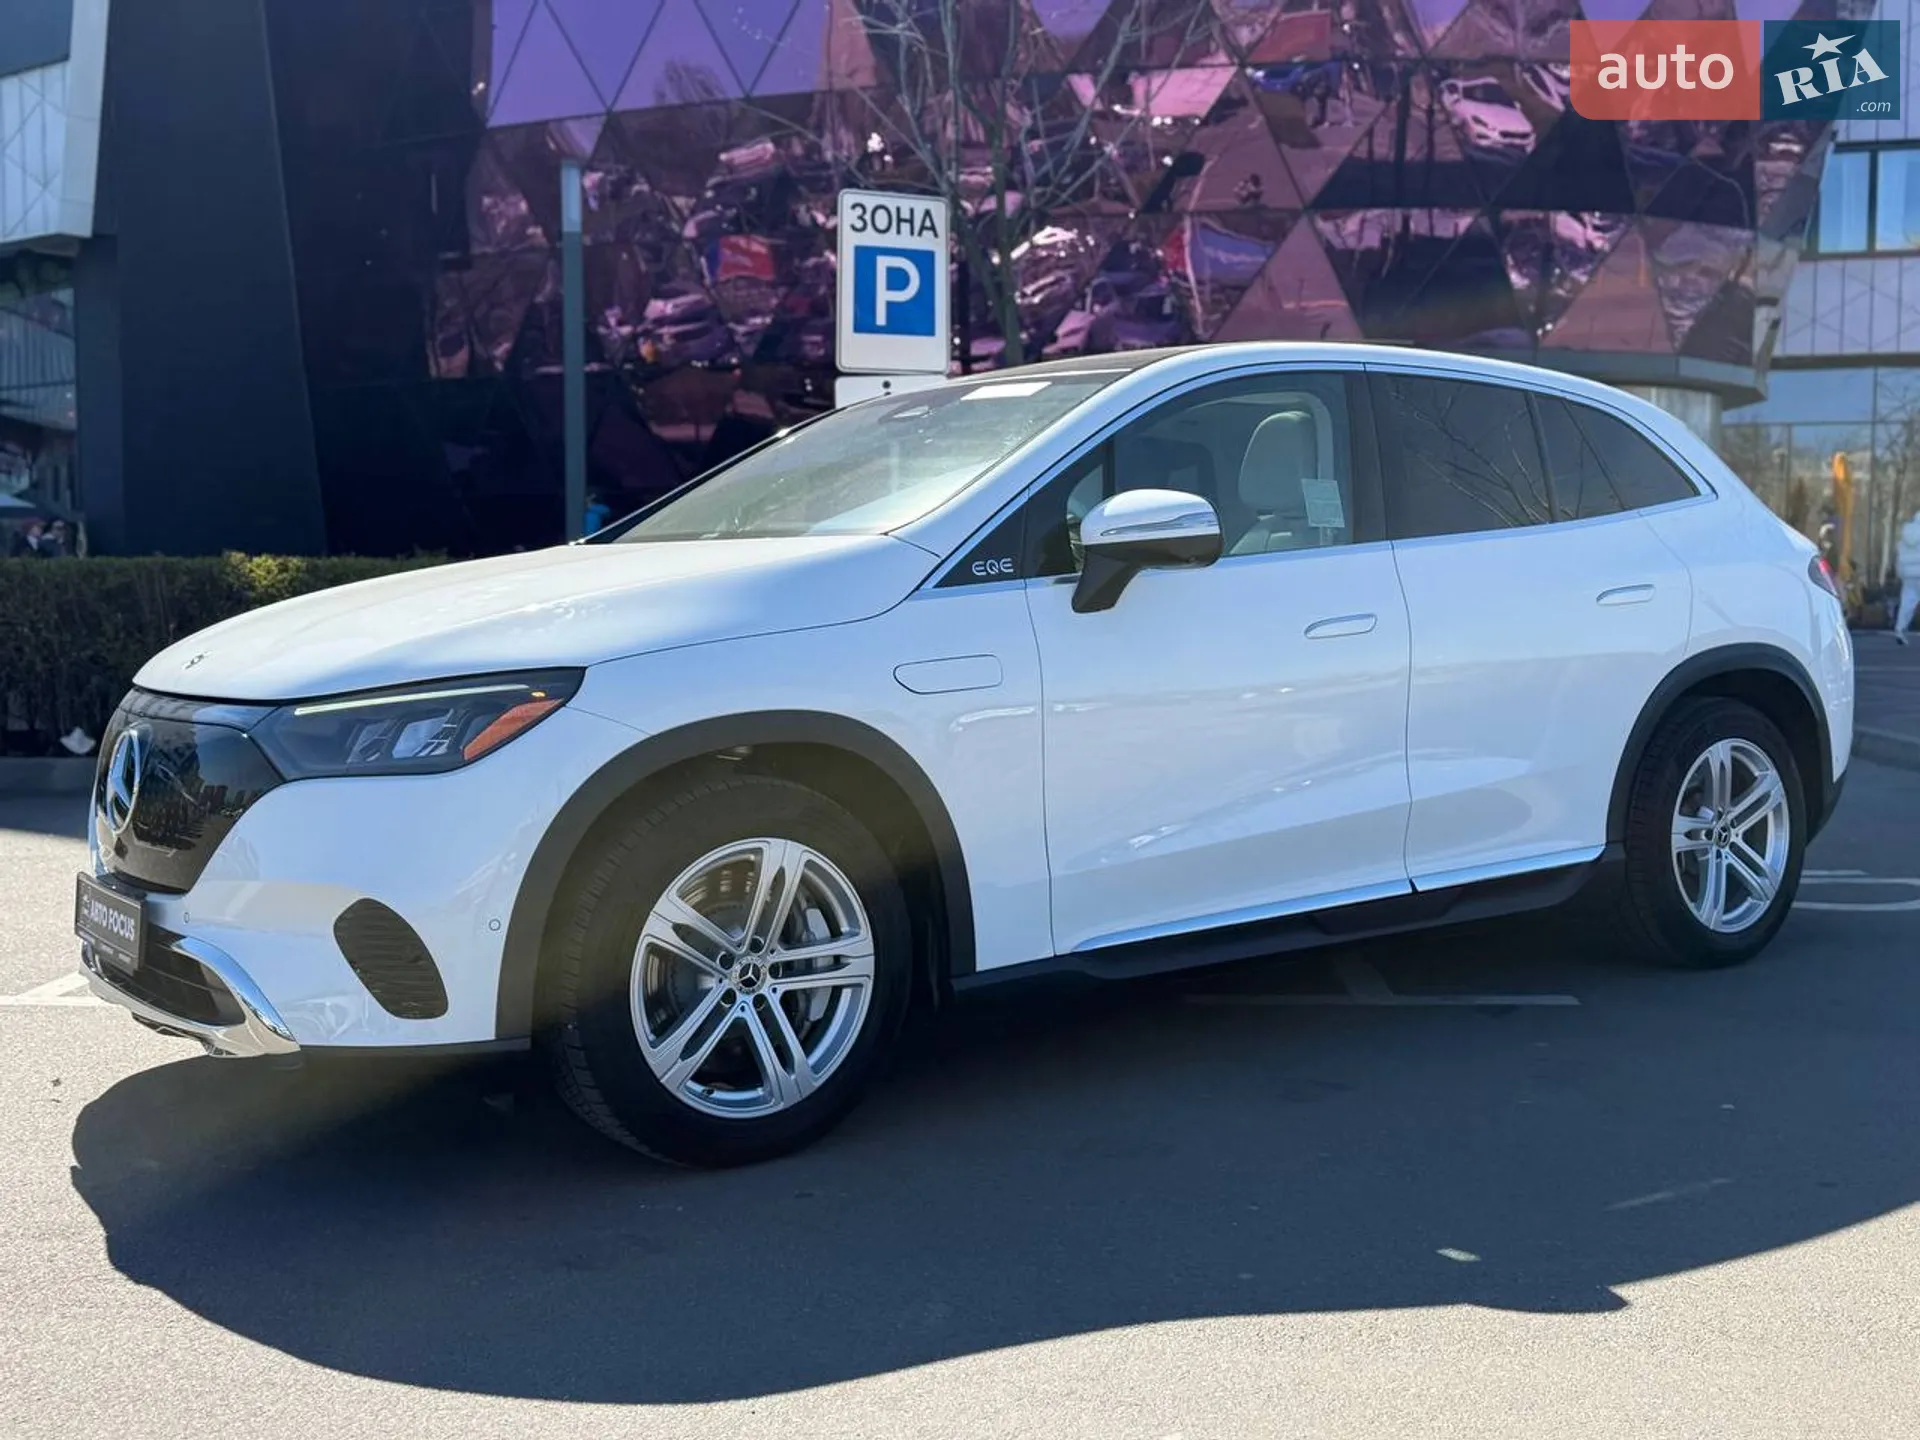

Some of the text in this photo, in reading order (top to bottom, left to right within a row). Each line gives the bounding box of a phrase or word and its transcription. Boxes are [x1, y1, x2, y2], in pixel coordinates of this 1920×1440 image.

[850, 203, 939, 238] ЗОНА
[875, 255, 920, 326] P
[972, 558, 1014, 576] EQE
[108, 907, 135, 941] FOCUS
